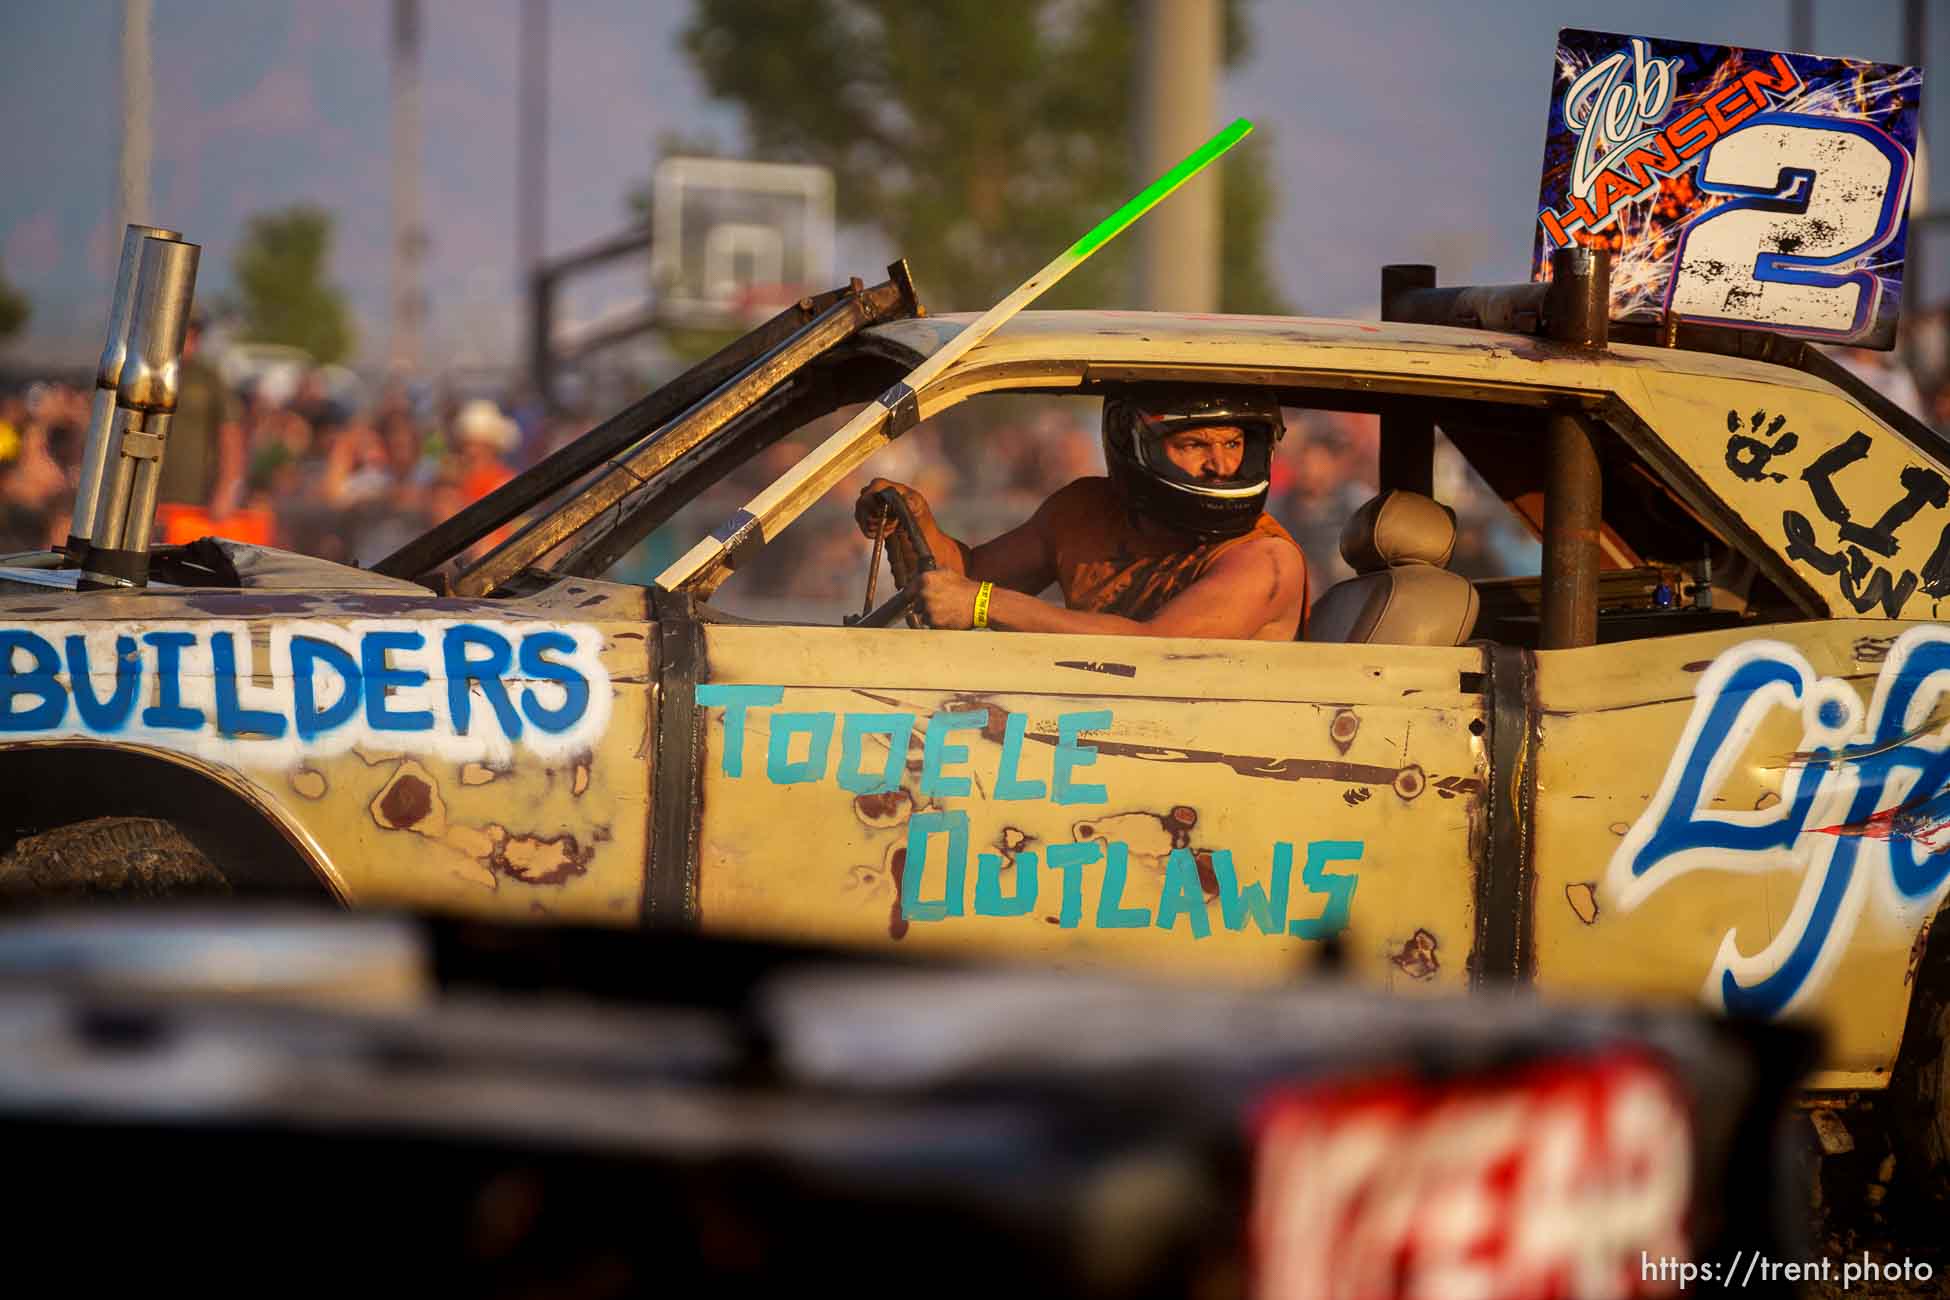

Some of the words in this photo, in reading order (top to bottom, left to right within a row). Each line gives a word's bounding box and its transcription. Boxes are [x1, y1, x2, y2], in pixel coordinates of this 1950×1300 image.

[1539, 54, 1802, 246] HANSEN
[1565, 37, 1682, 198] Zeb
[1667, 115, 1905, 335] 2
[0, 624, 590, 742] BUILDERS
[901, 810, 1364, 940] OUTLAWS
